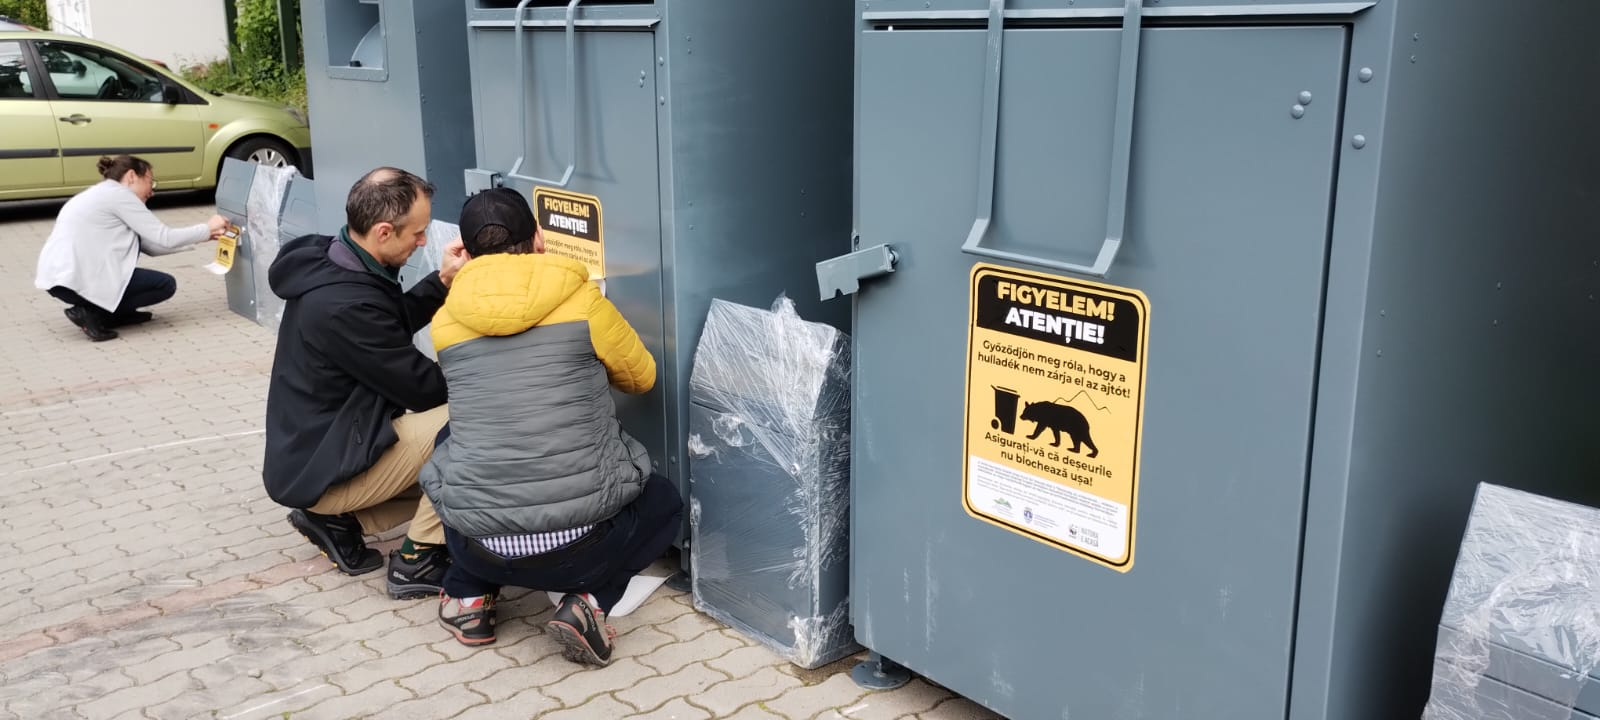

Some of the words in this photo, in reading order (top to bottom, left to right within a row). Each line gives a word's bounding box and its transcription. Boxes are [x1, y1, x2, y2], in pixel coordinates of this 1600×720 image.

[544, 197, 590, 218] FIGYELEM!
[549, 213, 588, 235] ATENȚIE!
[997, 281, 1115, 321] FIGYELEM!
[1005, 307, 1105, 344] ATENȚIE!
[978, 351, 1020, 370] hulladék
[1022, 364, 1045, 377] nem
[1047, 370, 1072, 384] zárja
[1074, 377, 1084, 387] el
[1086, 380, 1098, 391] az
[1100, 383, 1131, 398] ajtót!
[983, 340, 1035, 361] Győződjön
[1037, 354, 1061, 369] meg
[1063, 360, 1086, 374] róla,
[1089, 364, 1117, 382] hogy
[1119, 374, 1126, 382] a
[985, 431, 1045, 458] Asigurați-vă
[1047, 451, 1059, 462] că
[1062, 455, 1112, 478] deșeurile
[1001, 450, 1013, 461] nu
[1016, 453, 1068, 478] blochează
[1070, 472, 1093, 486] ușa!
